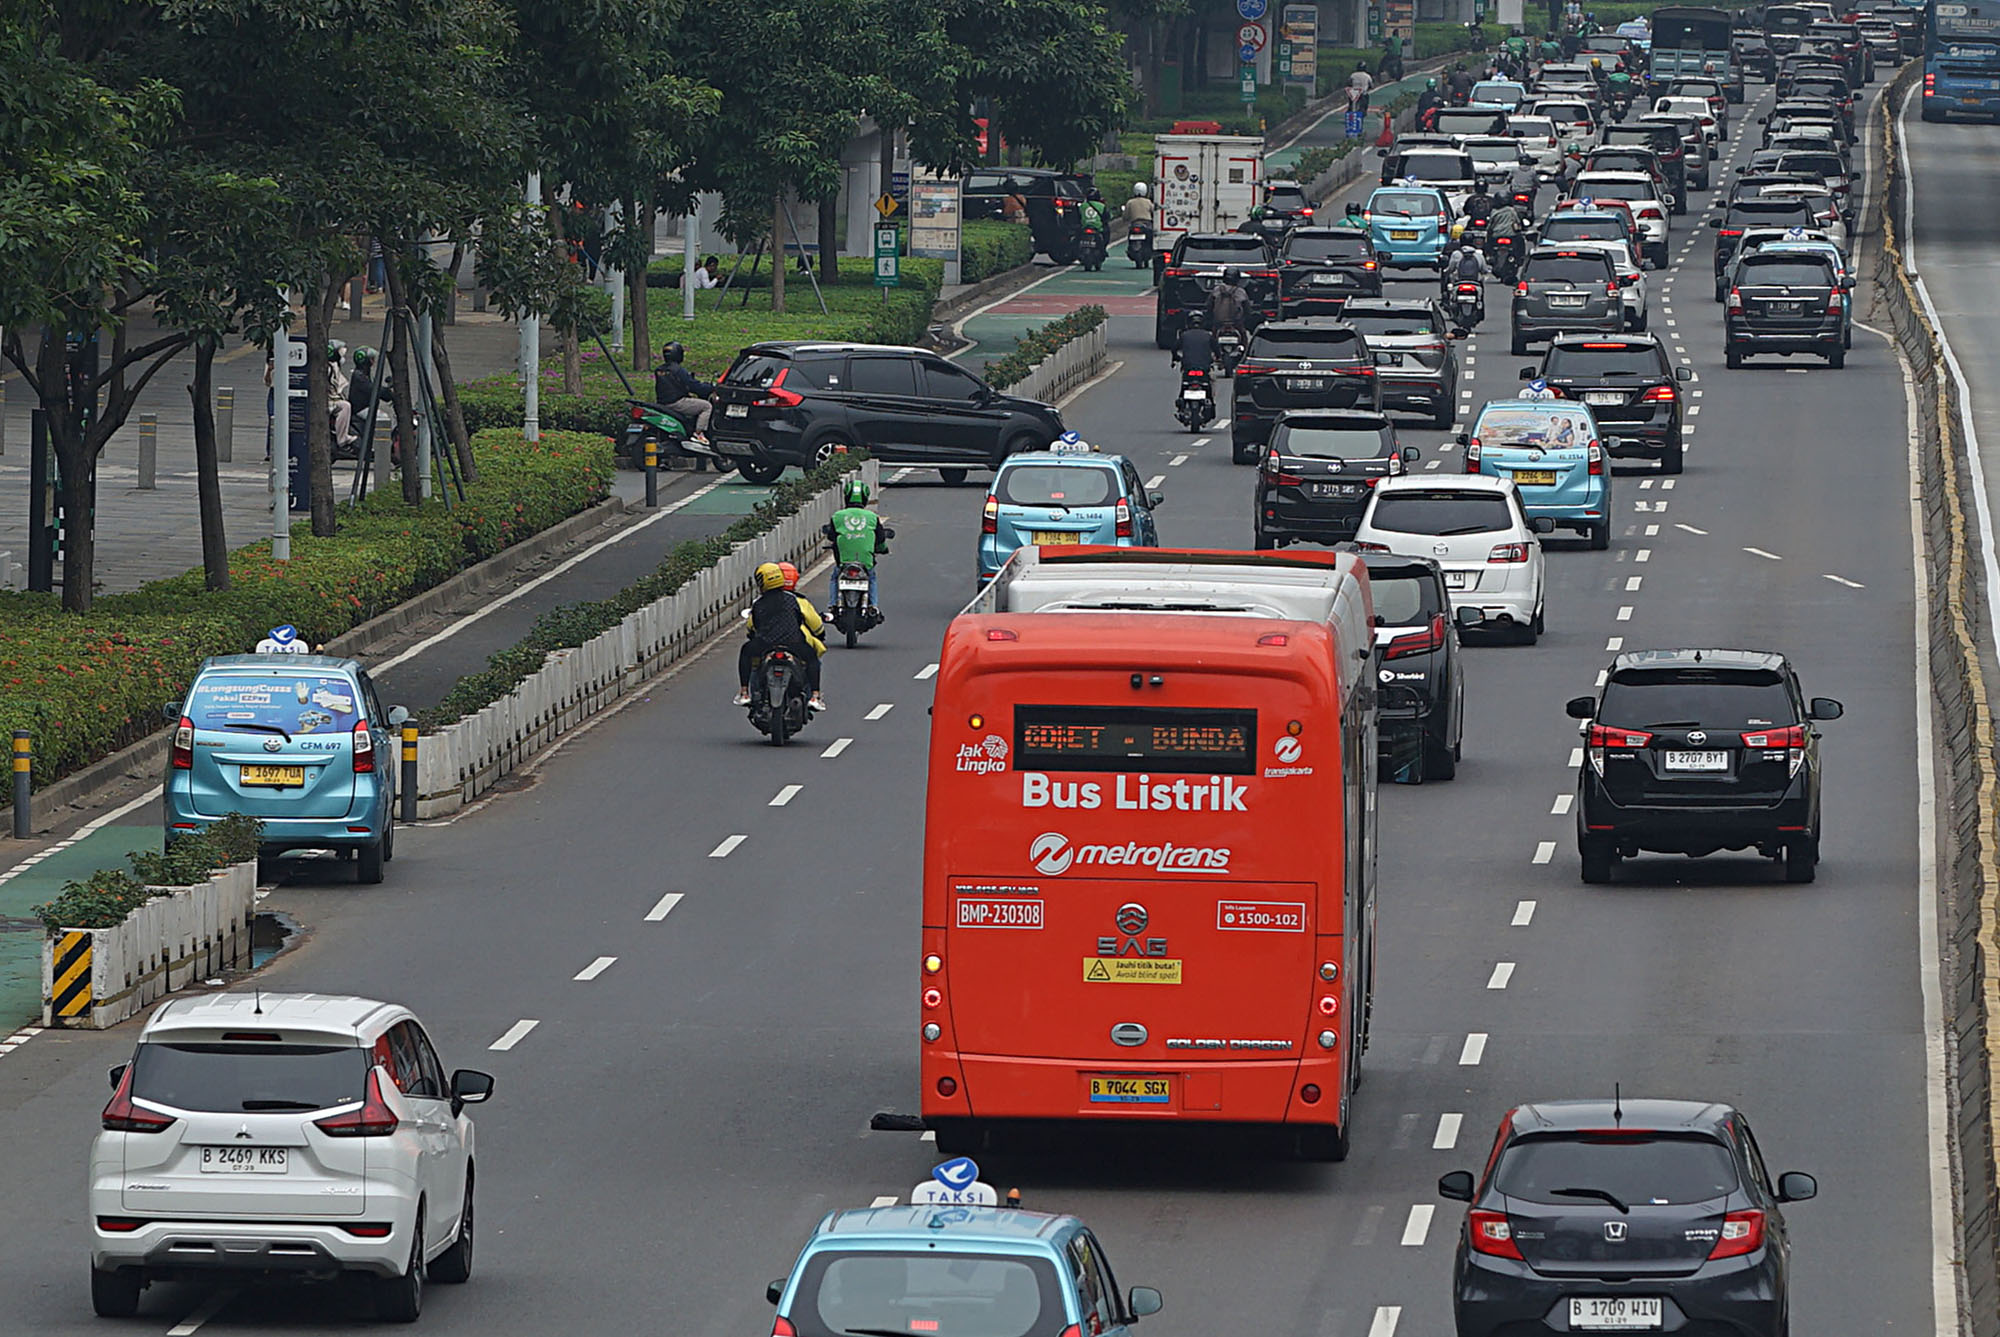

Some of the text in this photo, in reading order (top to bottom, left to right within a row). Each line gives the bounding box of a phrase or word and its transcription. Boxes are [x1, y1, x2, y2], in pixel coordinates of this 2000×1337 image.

[265, 646, 300, 654] TAKSI
[301, 742, 342, 751] CFM 697
[956, 744, 982, 758] Jak
[1669, 753, 1725, 764] B 2707 BYT
[243, 767, 302, 778] B 1697 TUA
[956, 758, 1006, 775] Lingko
[1022, 772, 1248, 811] Bus Listrik
[1076, 842, 1231, 874] metrotrans
[961, 903, 1040, 925] BMP-230308
[1239, 911, 1298, 927] 1500-102
[1166, 1039, 1226, 1050] GOLDEN
[1092, 1081, 1168, 1096] B 7044 SGX
[203, 1149, 286, 1164] B 2469 KKS
[926, 1190, 984, 1204] TAKSI
[1573, 1302, 1659, 1316] B 1709 WIV
